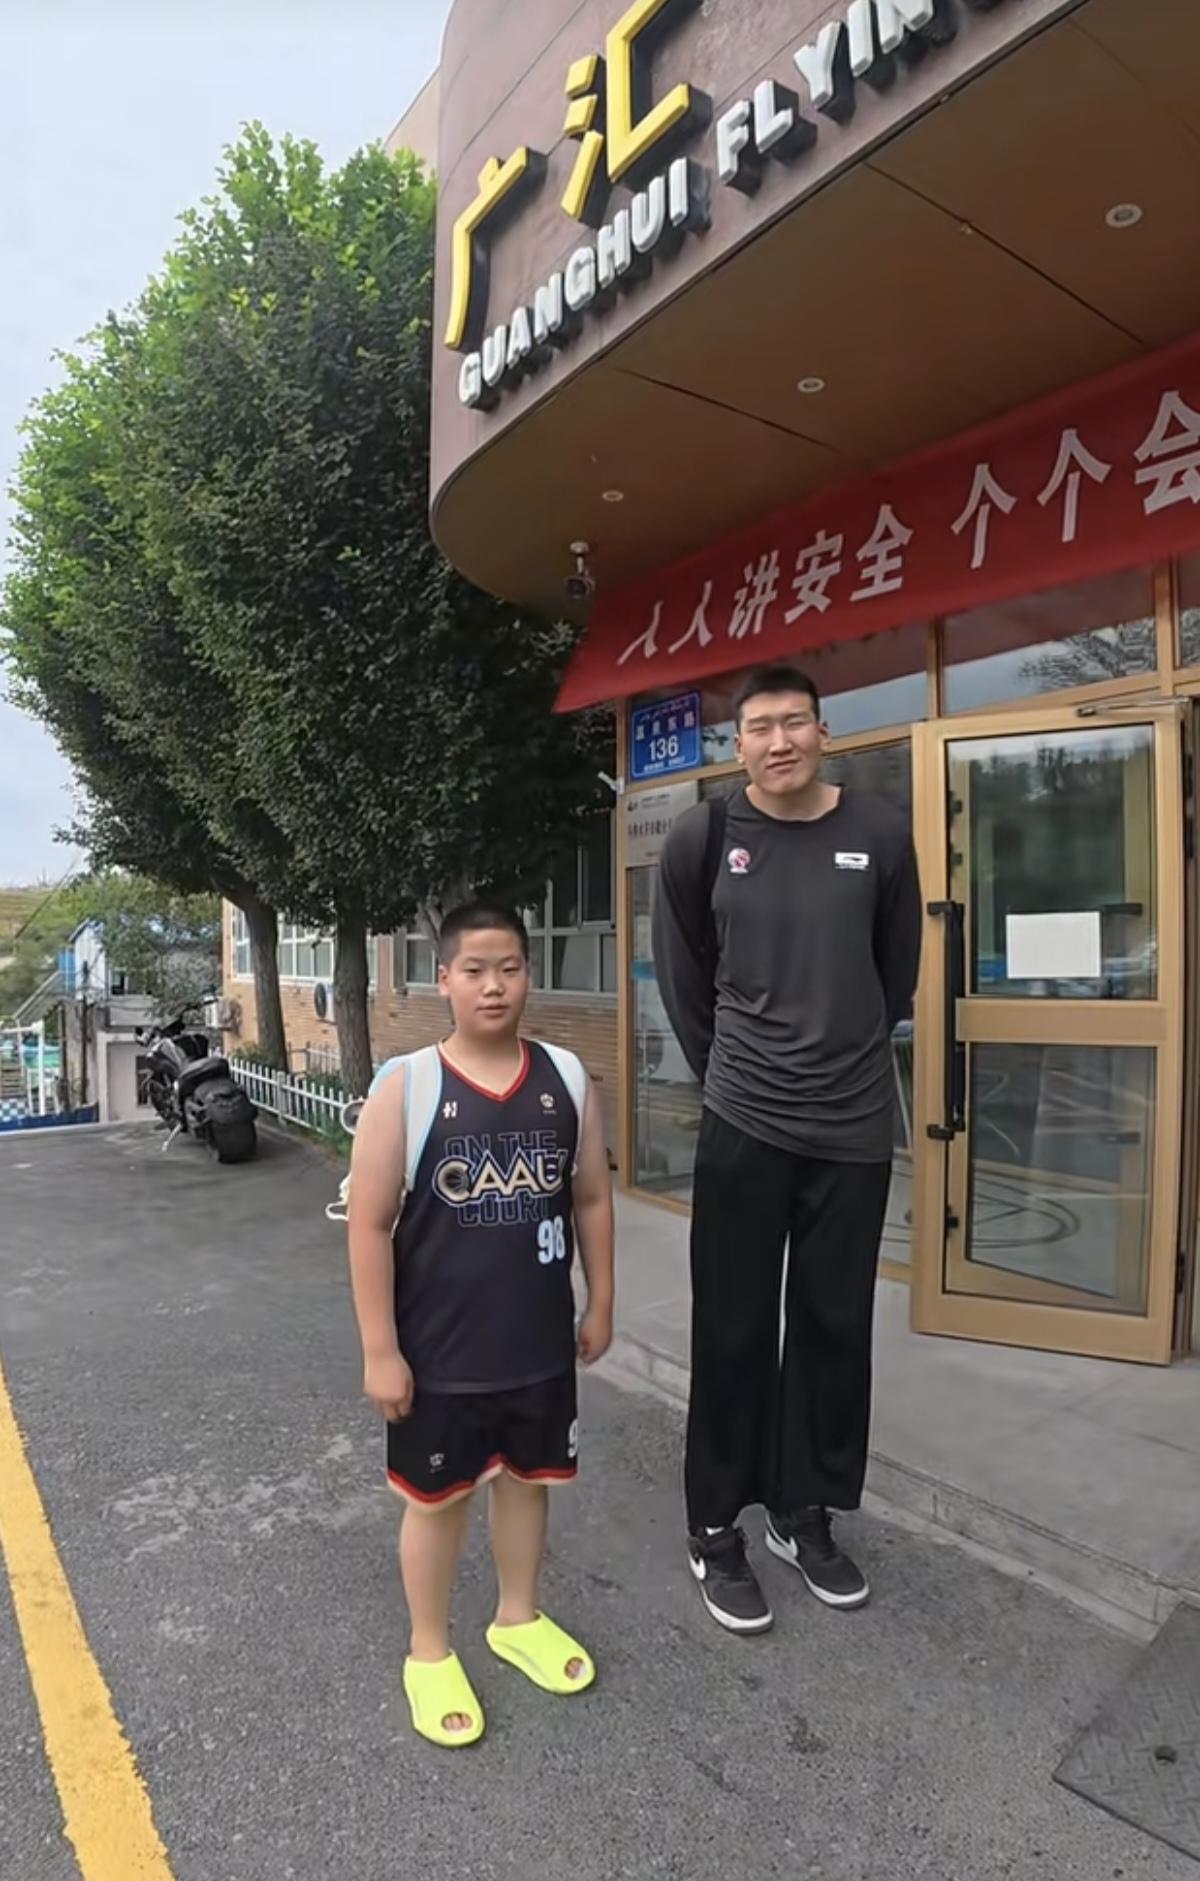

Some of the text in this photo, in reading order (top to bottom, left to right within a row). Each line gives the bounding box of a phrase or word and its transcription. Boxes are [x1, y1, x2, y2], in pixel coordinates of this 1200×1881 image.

[459, 157, 689, 404] GUANGHUI
[618, 390, 1200, 665] 人人讲安全 个个会
[649, 735, 679, 762] 136
[537, 1215, 566, 1265] 98
